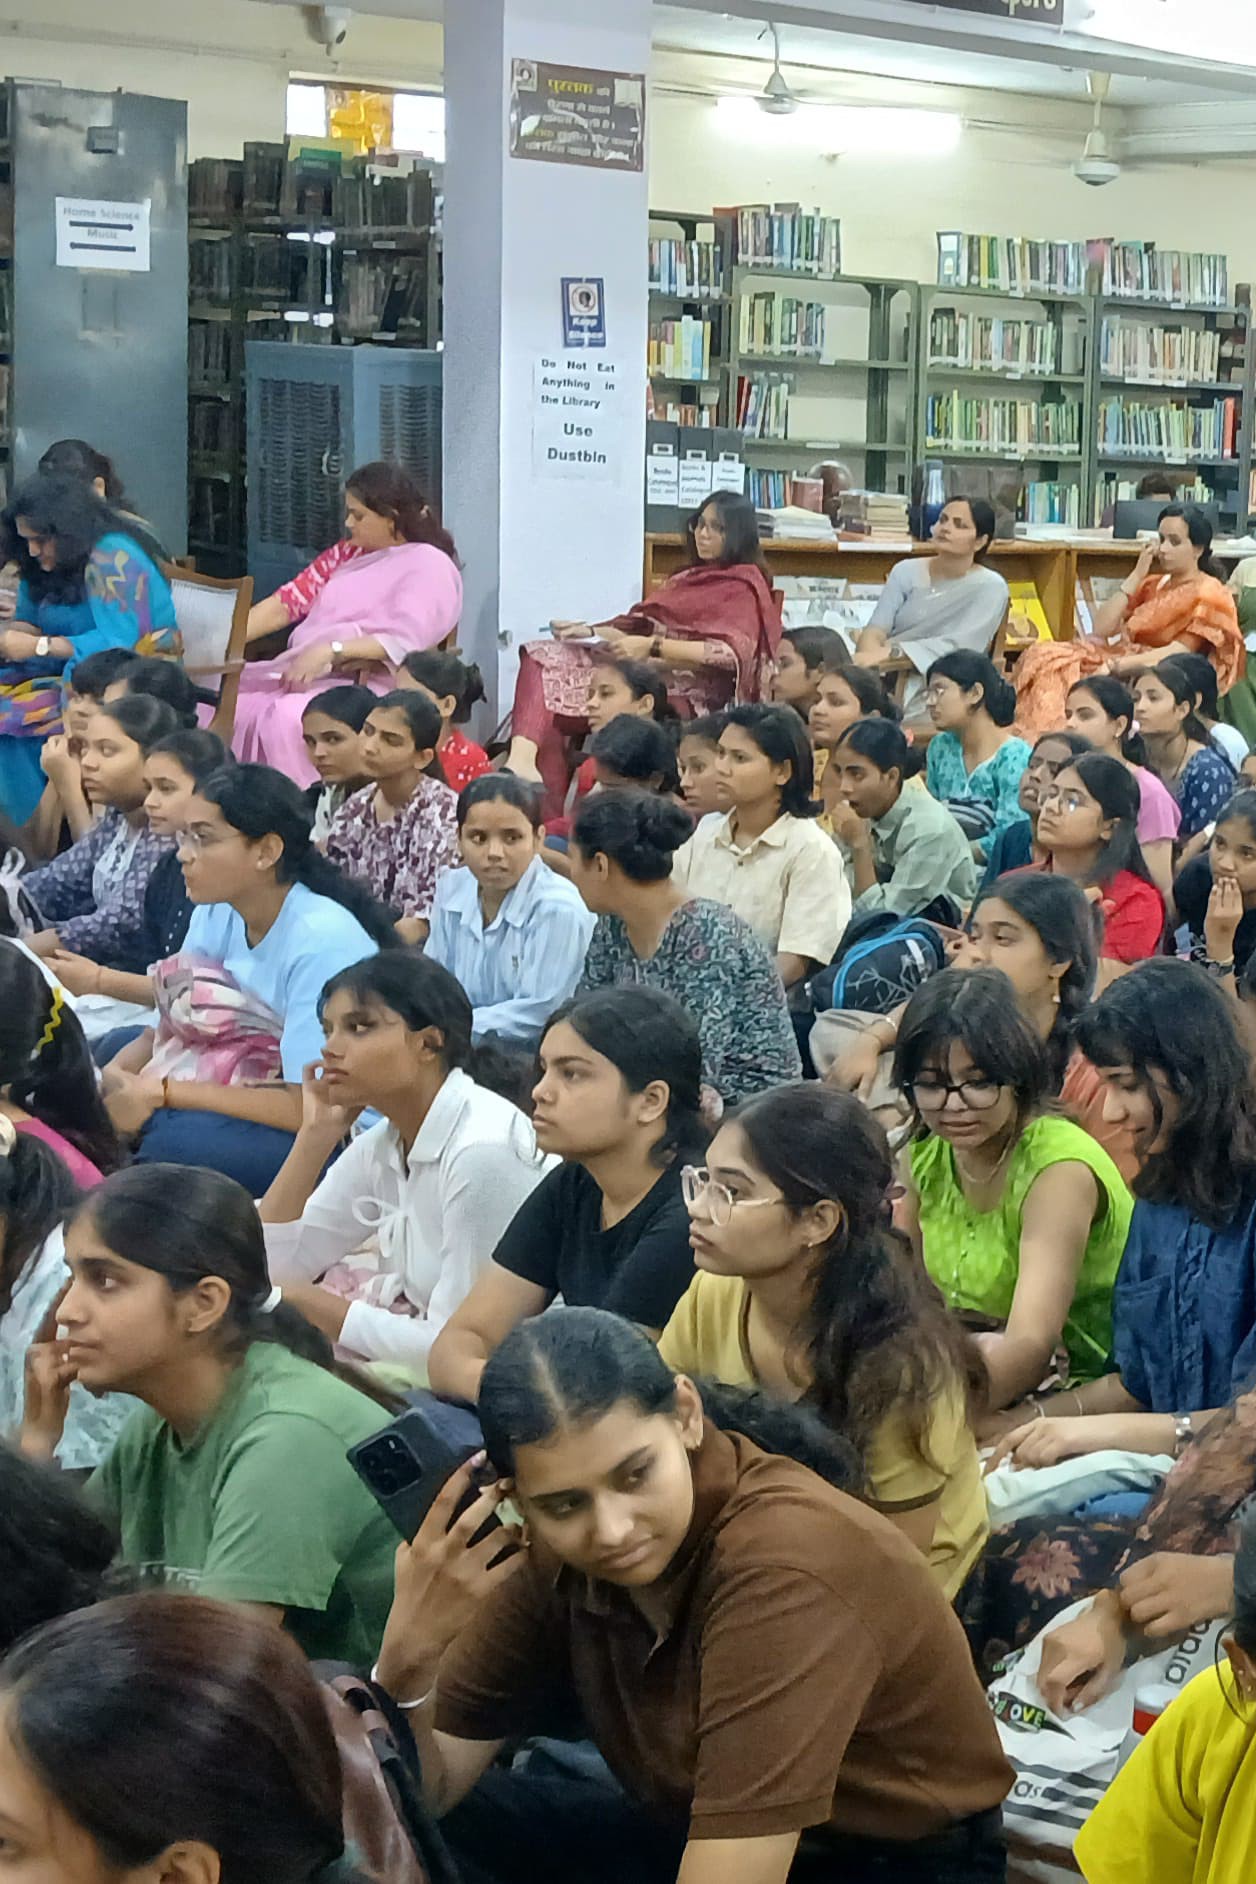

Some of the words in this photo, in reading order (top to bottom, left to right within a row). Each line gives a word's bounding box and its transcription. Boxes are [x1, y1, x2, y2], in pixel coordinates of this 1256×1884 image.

[63, 207, 97, 217] Home
[100, 208, 140, 220] Science
[541, 359, 557, 369] Do
[566, 360, 587, 371] Not
[597, 362, 615, 373] Eat
[542, 376, 591, 391] Anything
[604, 381, 615, 391] in
[541, 394, 559, 405] the
[562, 395, 601, 410] Library
[563, 423, 593, 437] Use
[547, 447, 607, 464] Dustbin
